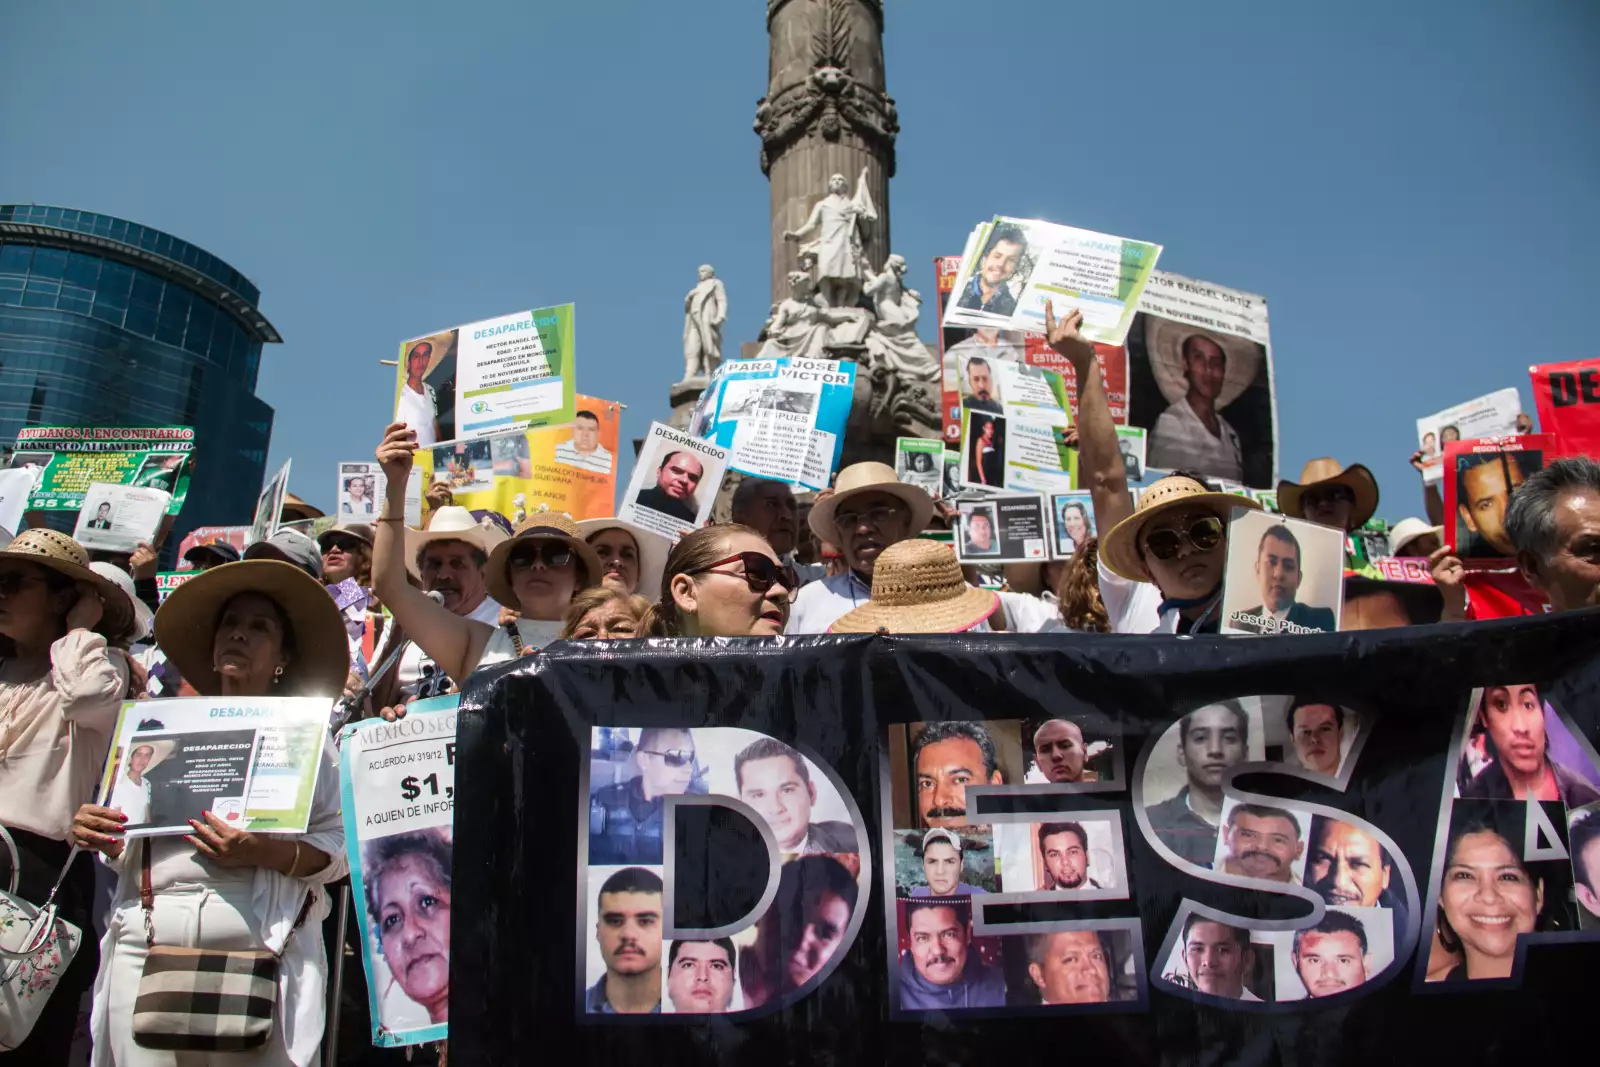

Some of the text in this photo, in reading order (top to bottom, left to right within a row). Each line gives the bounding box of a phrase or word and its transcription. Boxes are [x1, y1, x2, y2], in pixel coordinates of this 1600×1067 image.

[474, 315, 559, 340] DESAPARECIDO
[729, 362, 773, 371] PARA
[781, 368, 848, 384] VICTOR
[18, 428, 193, 440] AYUDANOS A ENCONTRARLO
[655, 427, 725, 460] DESAPARECIDO
[1231, 610, 1275, 628] Jesús
[183, 743, 251, 752] DESAPARECIDO
[369, 756, 407, 771] ACUERDO
[366, 815, 373, 827] A
[373, 809, 405, 825] QUIEN
[407, 805, 421, 817] DE
